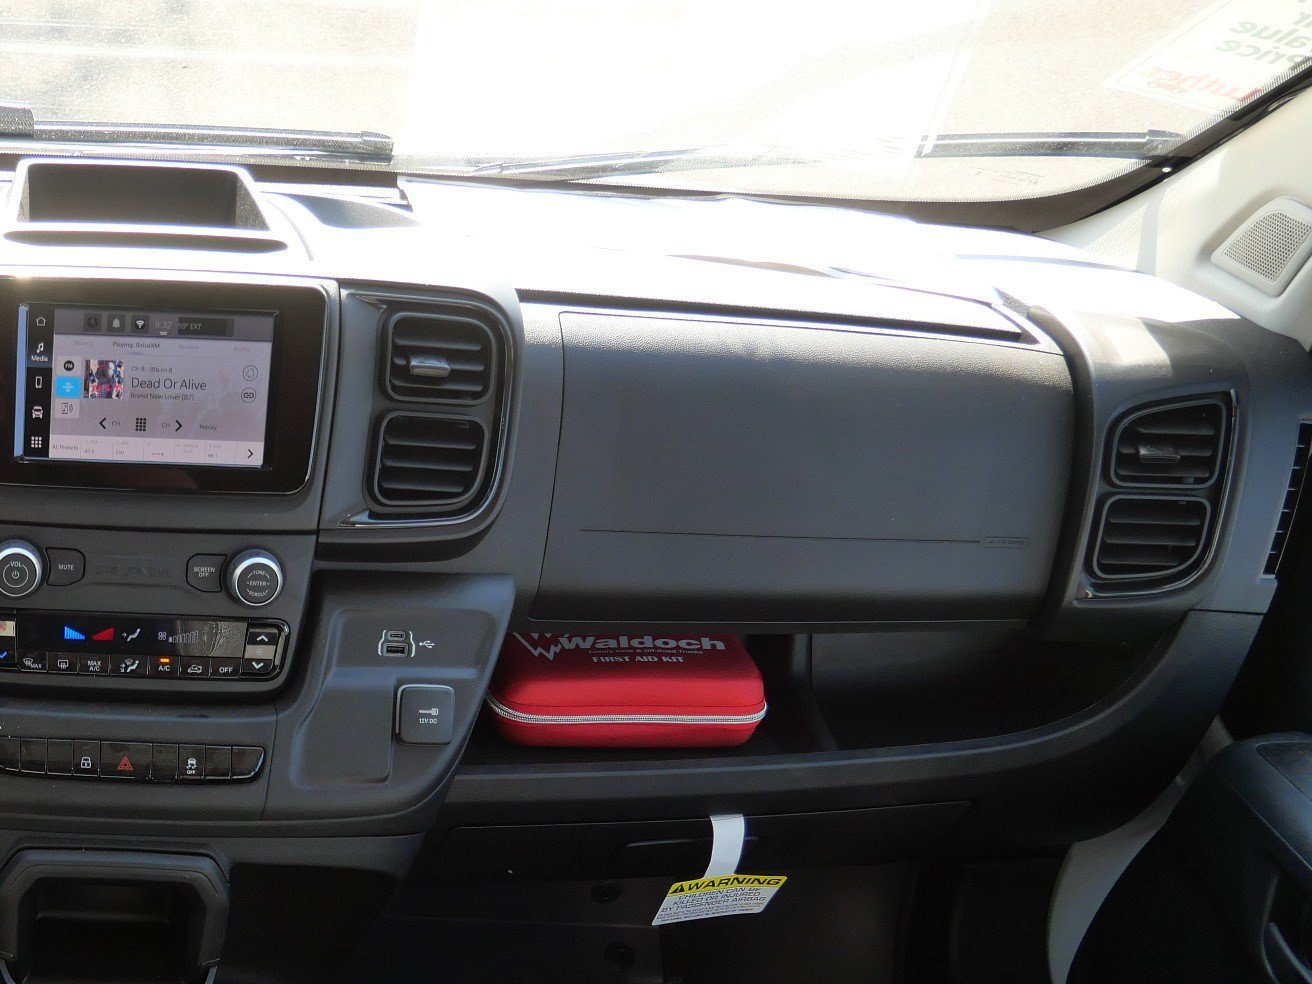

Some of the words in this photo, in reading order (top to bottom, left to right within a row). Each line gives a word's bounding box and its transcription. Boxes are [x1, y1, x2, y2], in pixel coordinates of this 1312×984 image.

[131, 377, 161, 389] Dead
[163, 378, 178, 390] Or
[180, 378, 207, 391] Alive
[558, 636, 726, 650] Waldoch
[689, 876, 782, 891] WARNING
[673, 897, 704, 906] KILLED
[678, 890, 725, 900] CHILDREN
